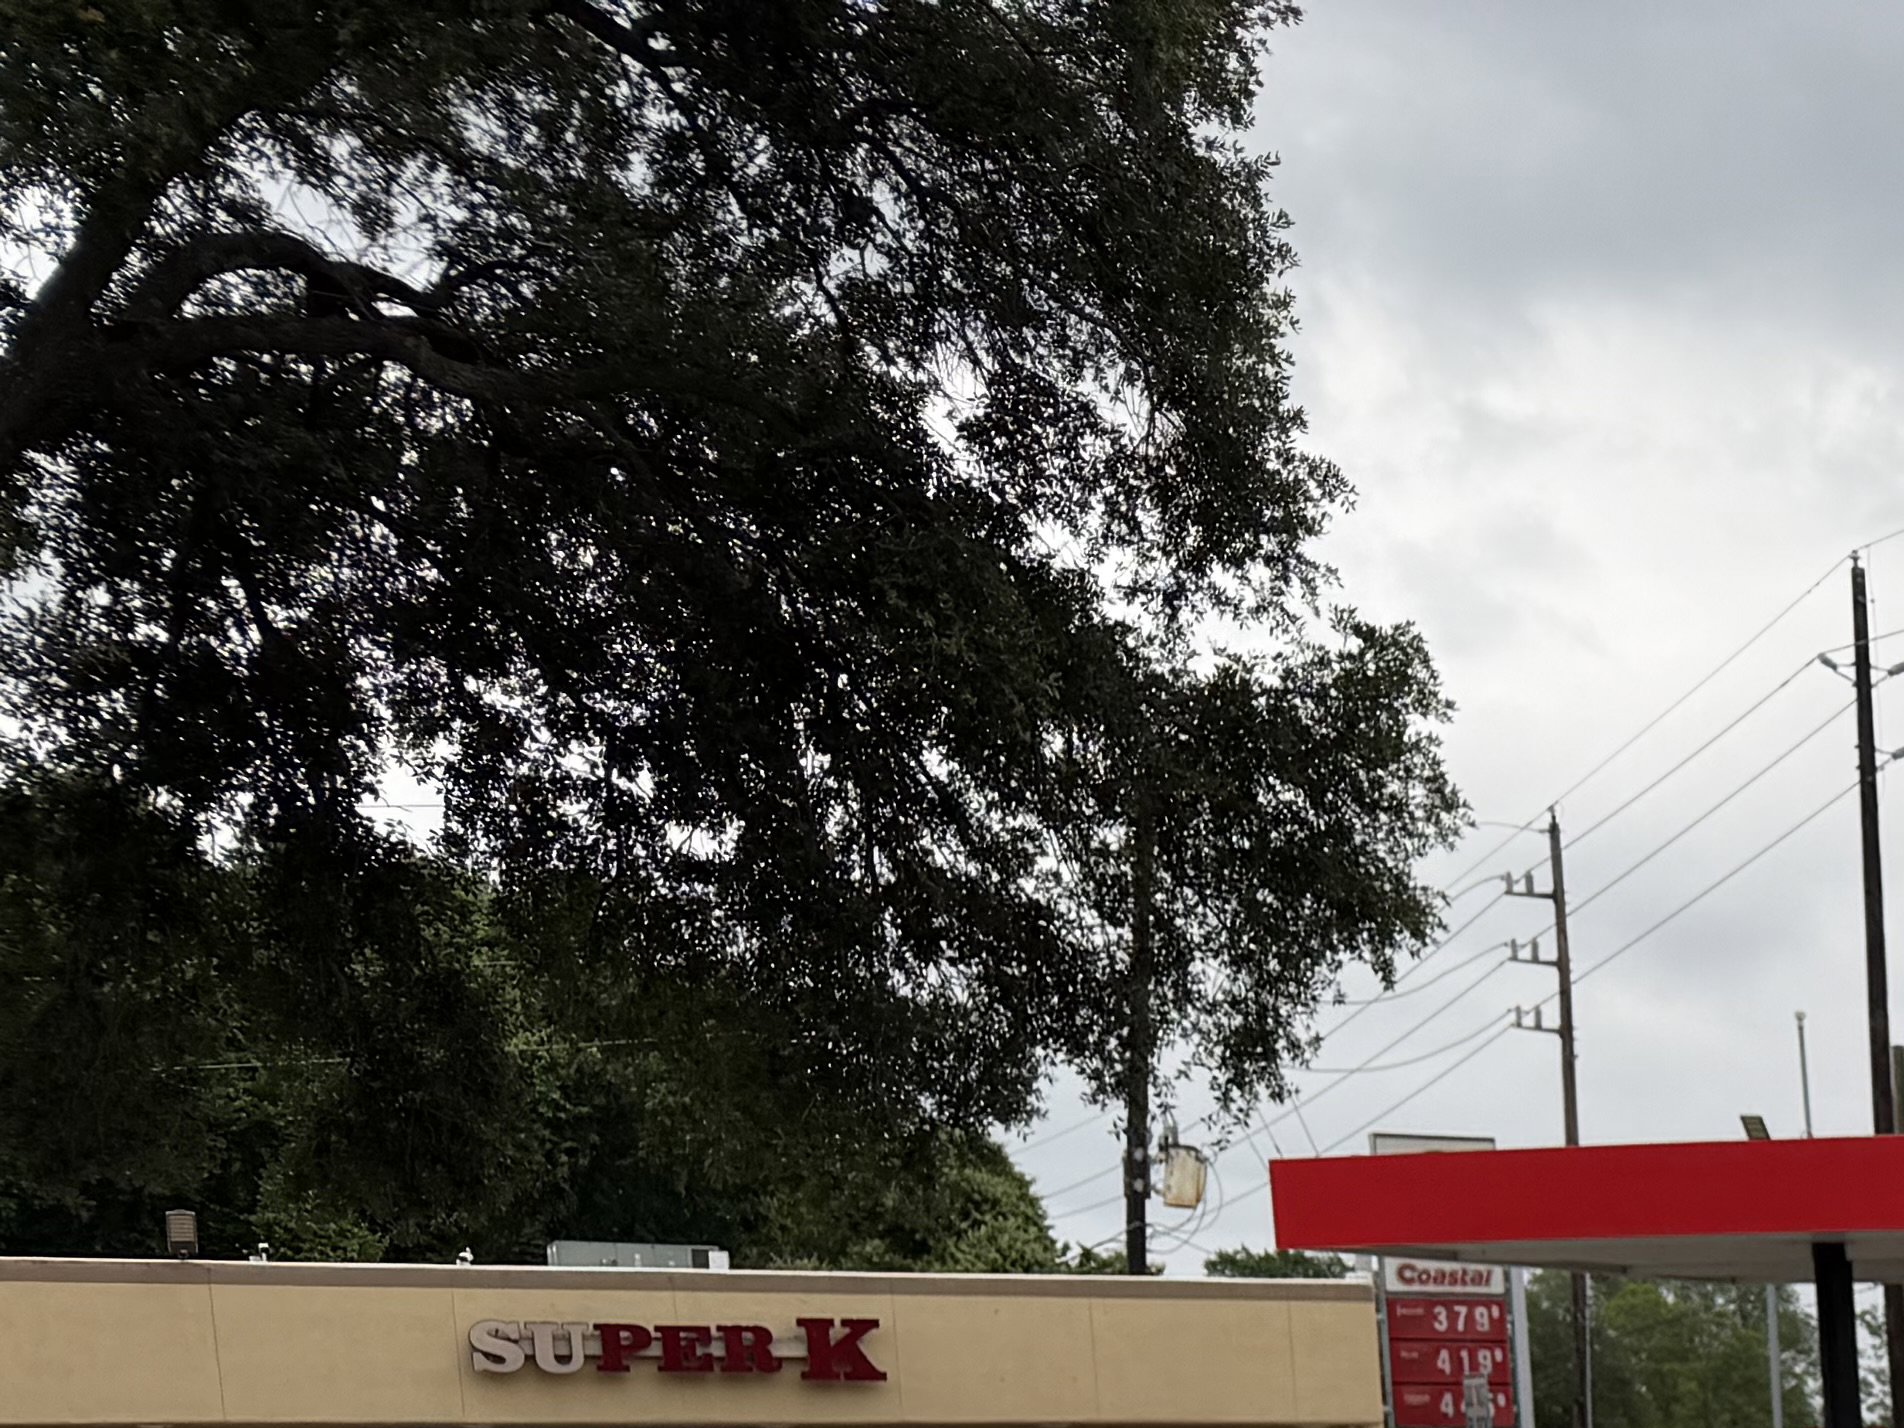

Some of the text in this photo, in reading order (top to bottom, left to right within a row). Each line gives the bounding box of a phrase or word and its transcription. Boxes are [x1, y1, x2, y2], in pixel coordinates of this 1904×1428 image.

[1396, 1263, 1492, 1287] Coastal
[467, 1317, 888, 1382] SUPER K
